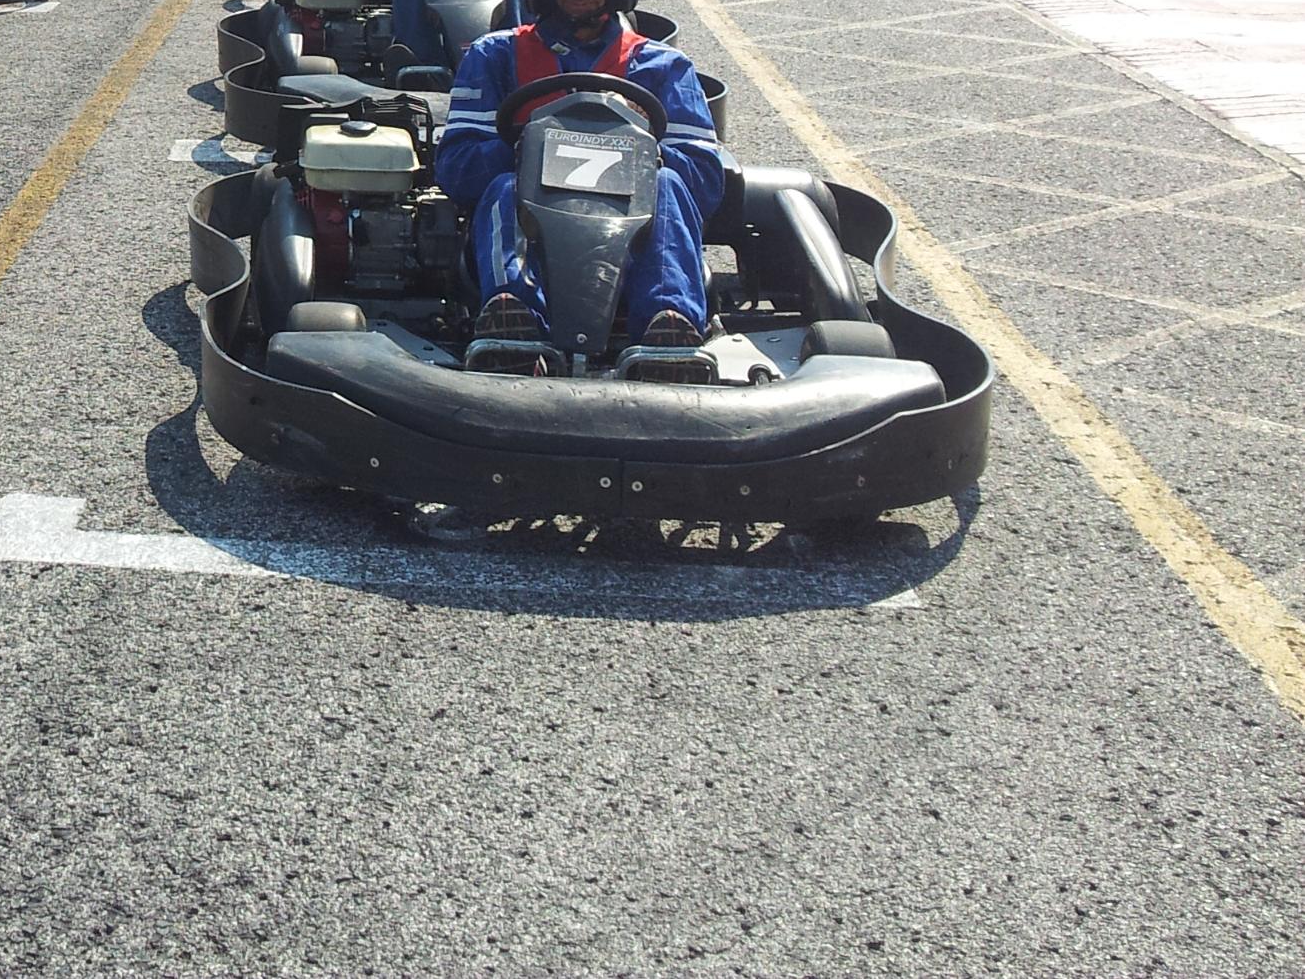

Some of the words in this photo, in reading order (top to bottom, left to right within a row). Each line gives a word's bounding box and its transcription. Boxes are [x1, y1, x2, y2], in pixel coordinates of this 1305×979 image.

[547, 130, 609, 146] EUROINDY
[609, 137, 632, 149] XXI
[555, 144, 623, 188] 7
